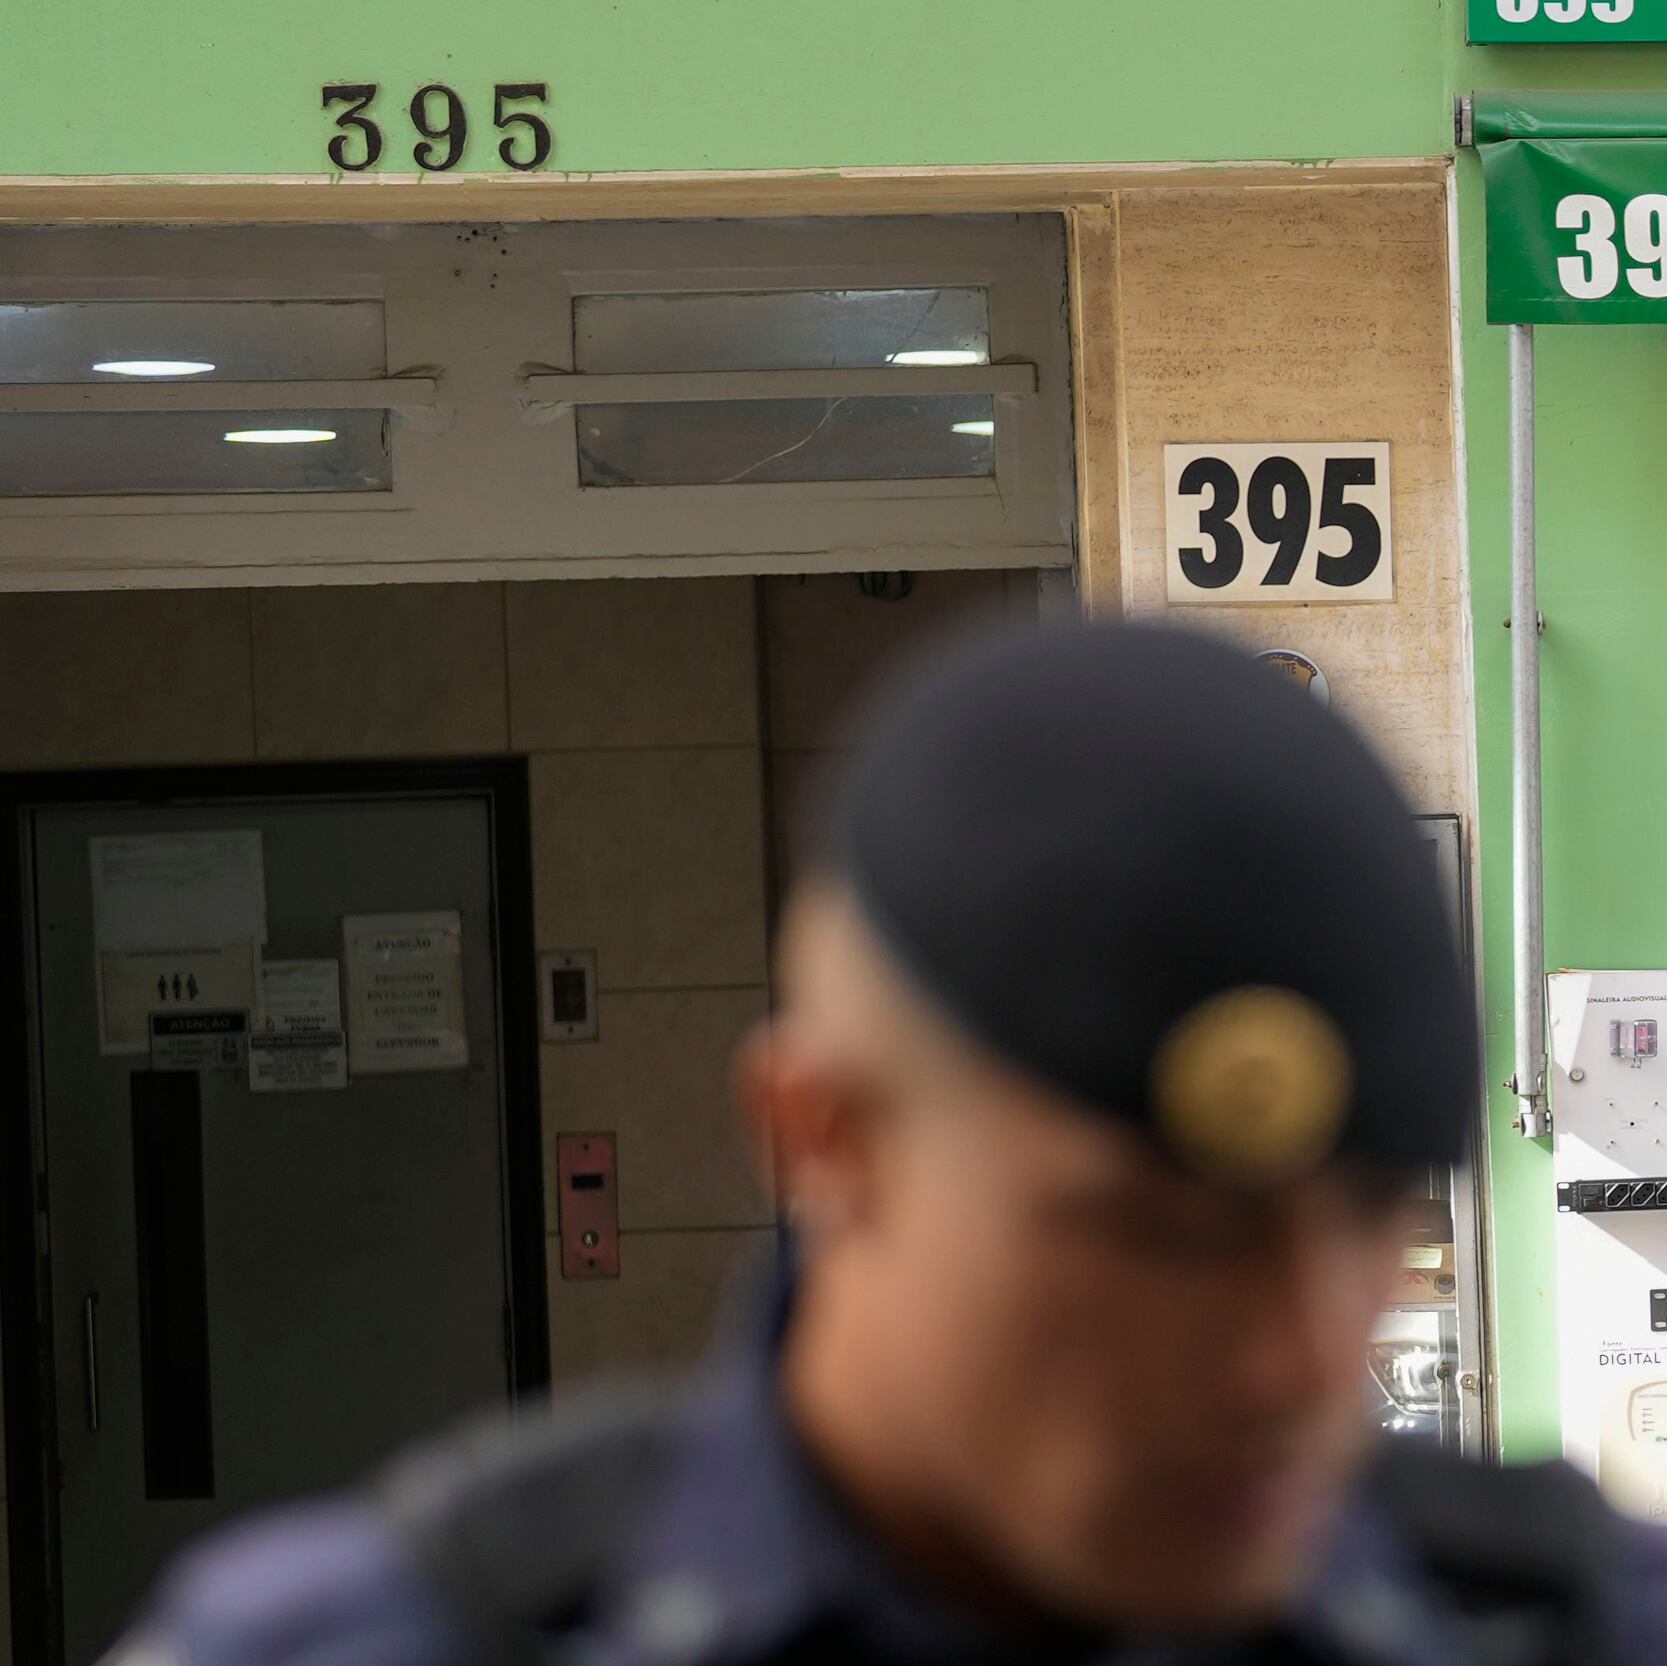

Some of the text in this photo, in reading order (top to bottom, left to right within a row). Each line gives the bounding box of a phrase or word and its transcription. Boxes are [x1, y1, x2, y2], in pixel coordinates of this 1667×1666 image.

[322, 83, 553, 172] 395
[1178, 455, 1383, 590] 395
[1599, 1352, 1661, 1366] DIGITAL
